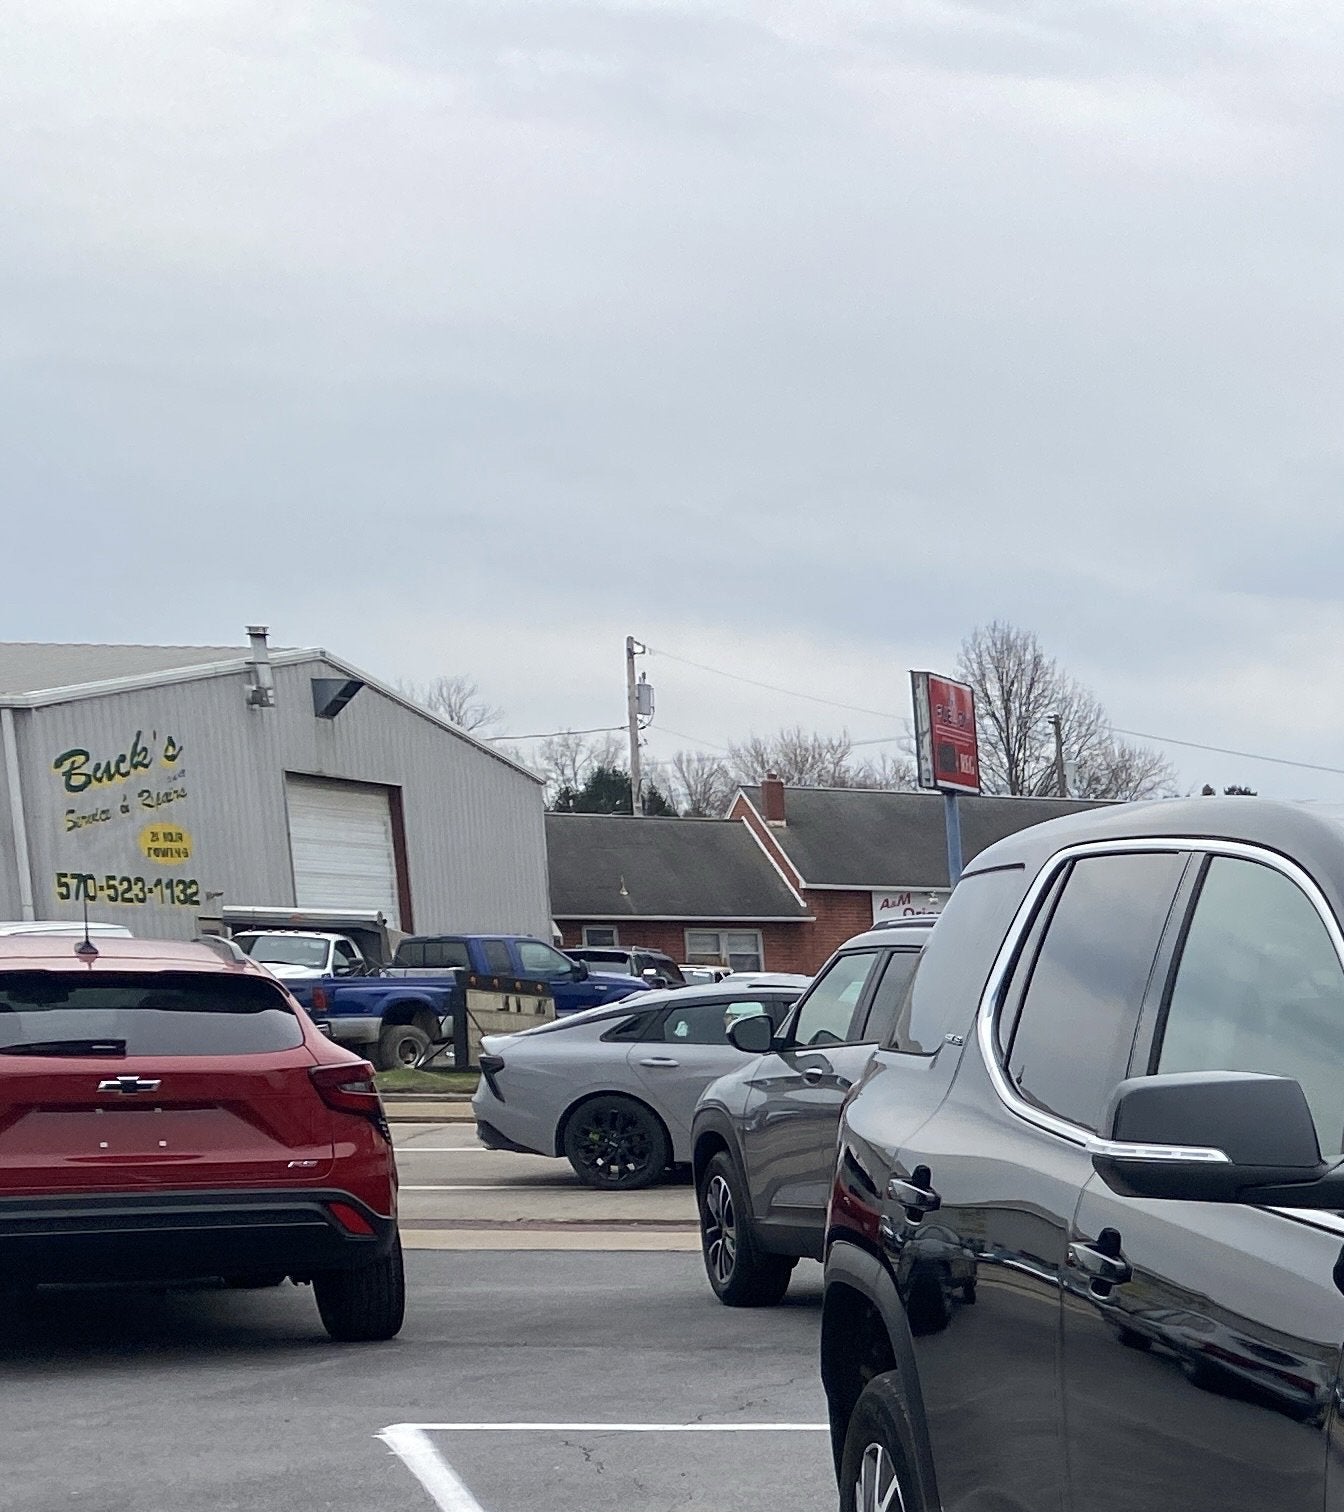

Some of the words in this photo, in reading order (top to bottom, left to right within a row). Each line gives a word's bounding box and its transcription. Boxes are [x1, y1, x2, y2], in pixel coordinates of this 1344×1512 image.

[53, 730, 183, 793] Buck's
[147, 847, 189, 859] TOWING
[55, 872, 201, 906] 570-523-1132
